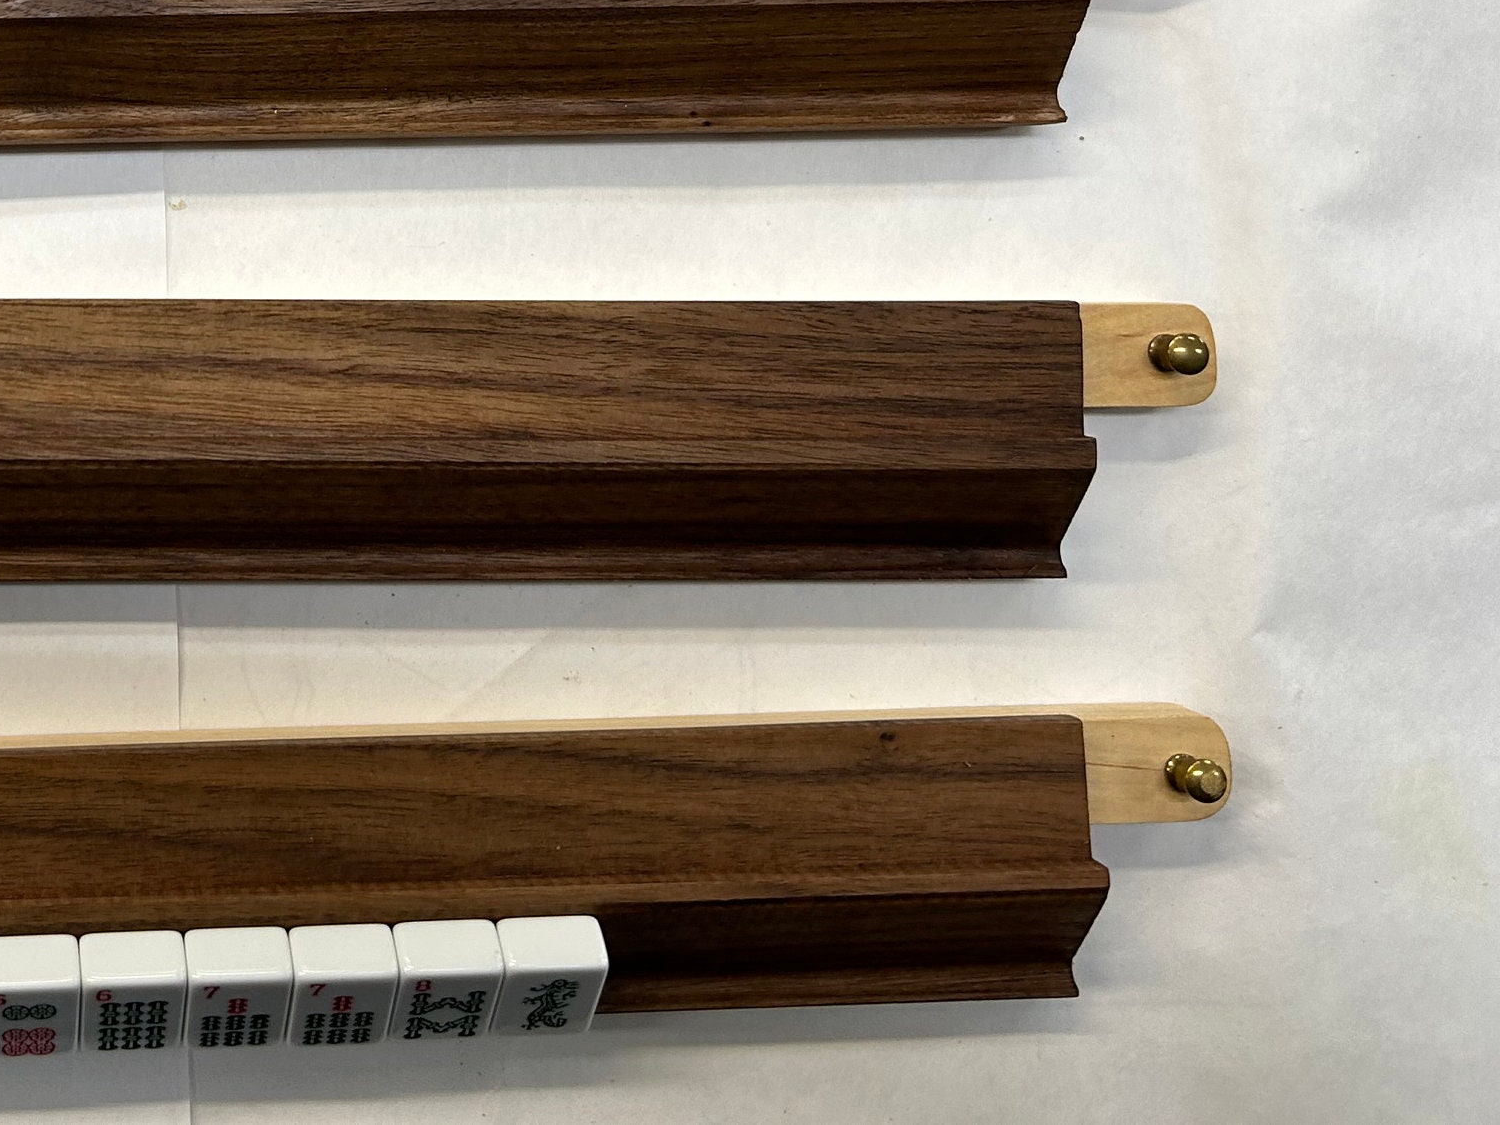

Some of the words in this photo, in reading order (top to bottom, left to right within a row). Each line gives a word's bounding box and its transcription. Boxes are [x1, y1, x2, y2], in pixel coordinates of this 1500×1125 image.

[204, 985, 221, 999] 7
[310, 984, 327, 998] 7
[415, 980, 433, 993] 8
[94, 989, 113, 1003] 6
